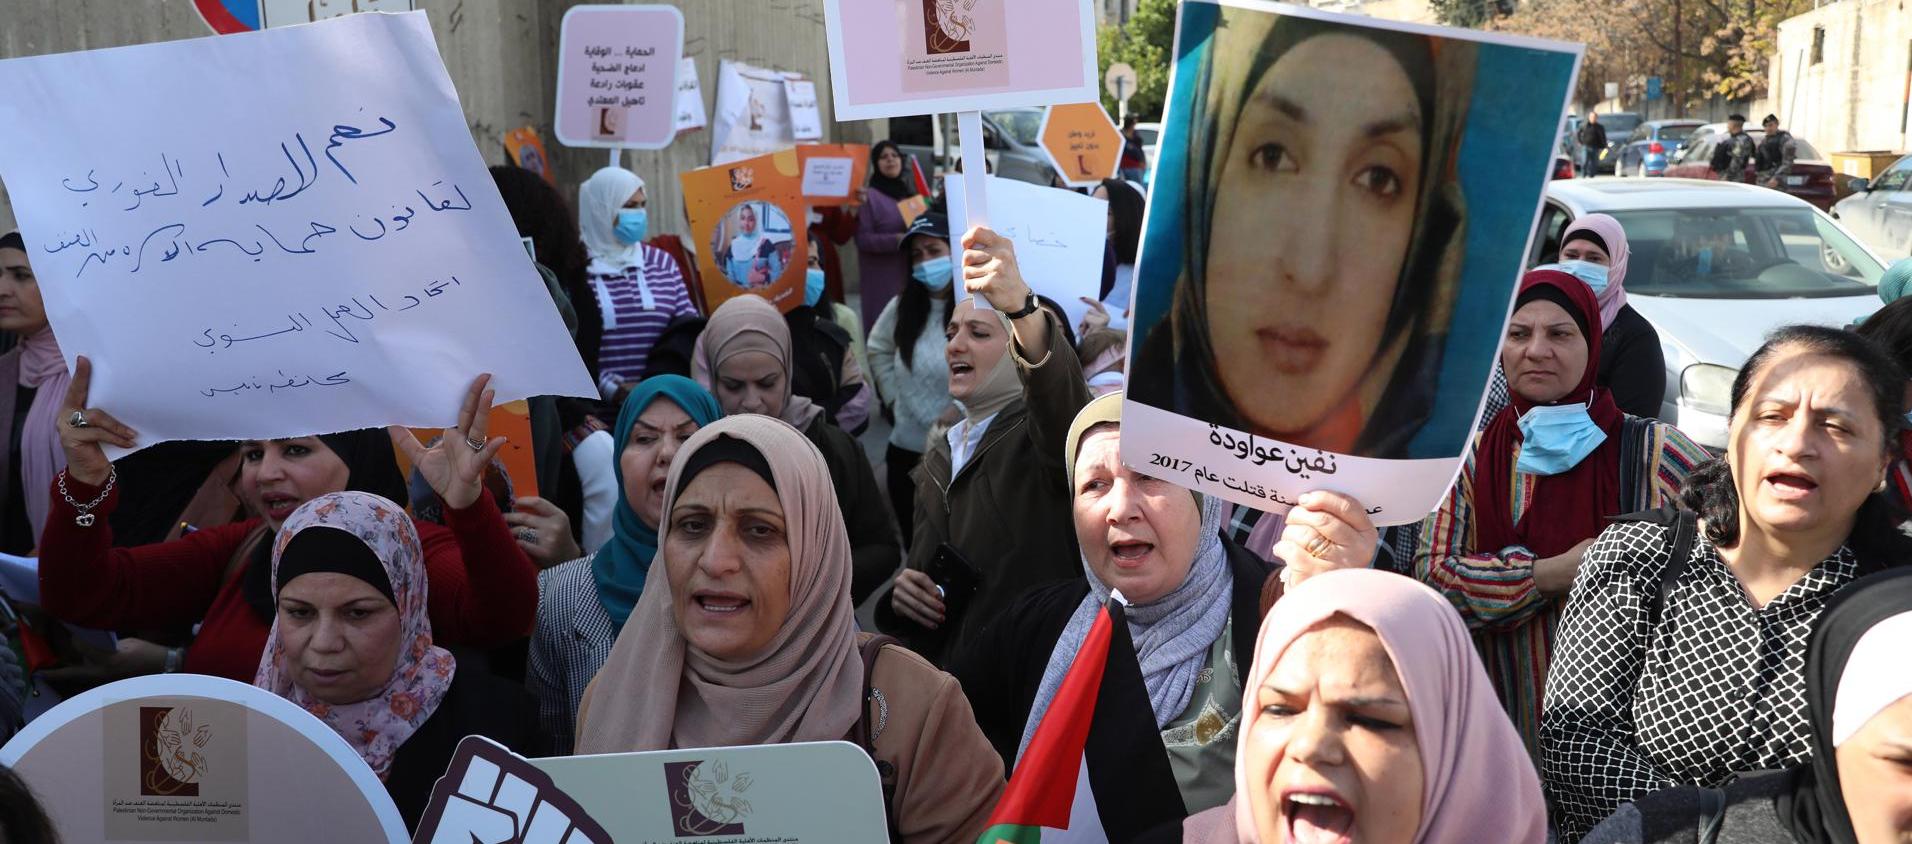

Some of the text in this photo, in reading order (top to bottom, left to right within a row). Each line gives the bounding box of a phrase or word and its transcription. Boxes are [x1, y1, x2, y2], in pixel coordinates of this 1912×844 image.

[584, 46, 612, 59] الوقاية
[625, 46, 655, 59] الحماية
[591, 62, 646, 75] ادماج الضحية
[590, 79, 645, 91] عقوبات رادعة
[587, 96, 620, 107] المعتدي
[324, 107, 396, 184] نعم
[62, 152, 183, 211] الفوري
[349, 179, 473, 241] لقانون
[43, 228, 98, 254] العنف
[193, 276, 460, 355] اتحاد العمل النسوي
[1209, 423, 1337, 479] نفين عواودة
[1149, 453, 1193, 472] 2017
[1194, 466, 1220, 486] عام
[1223, 476, 1266, 500] قتلت
